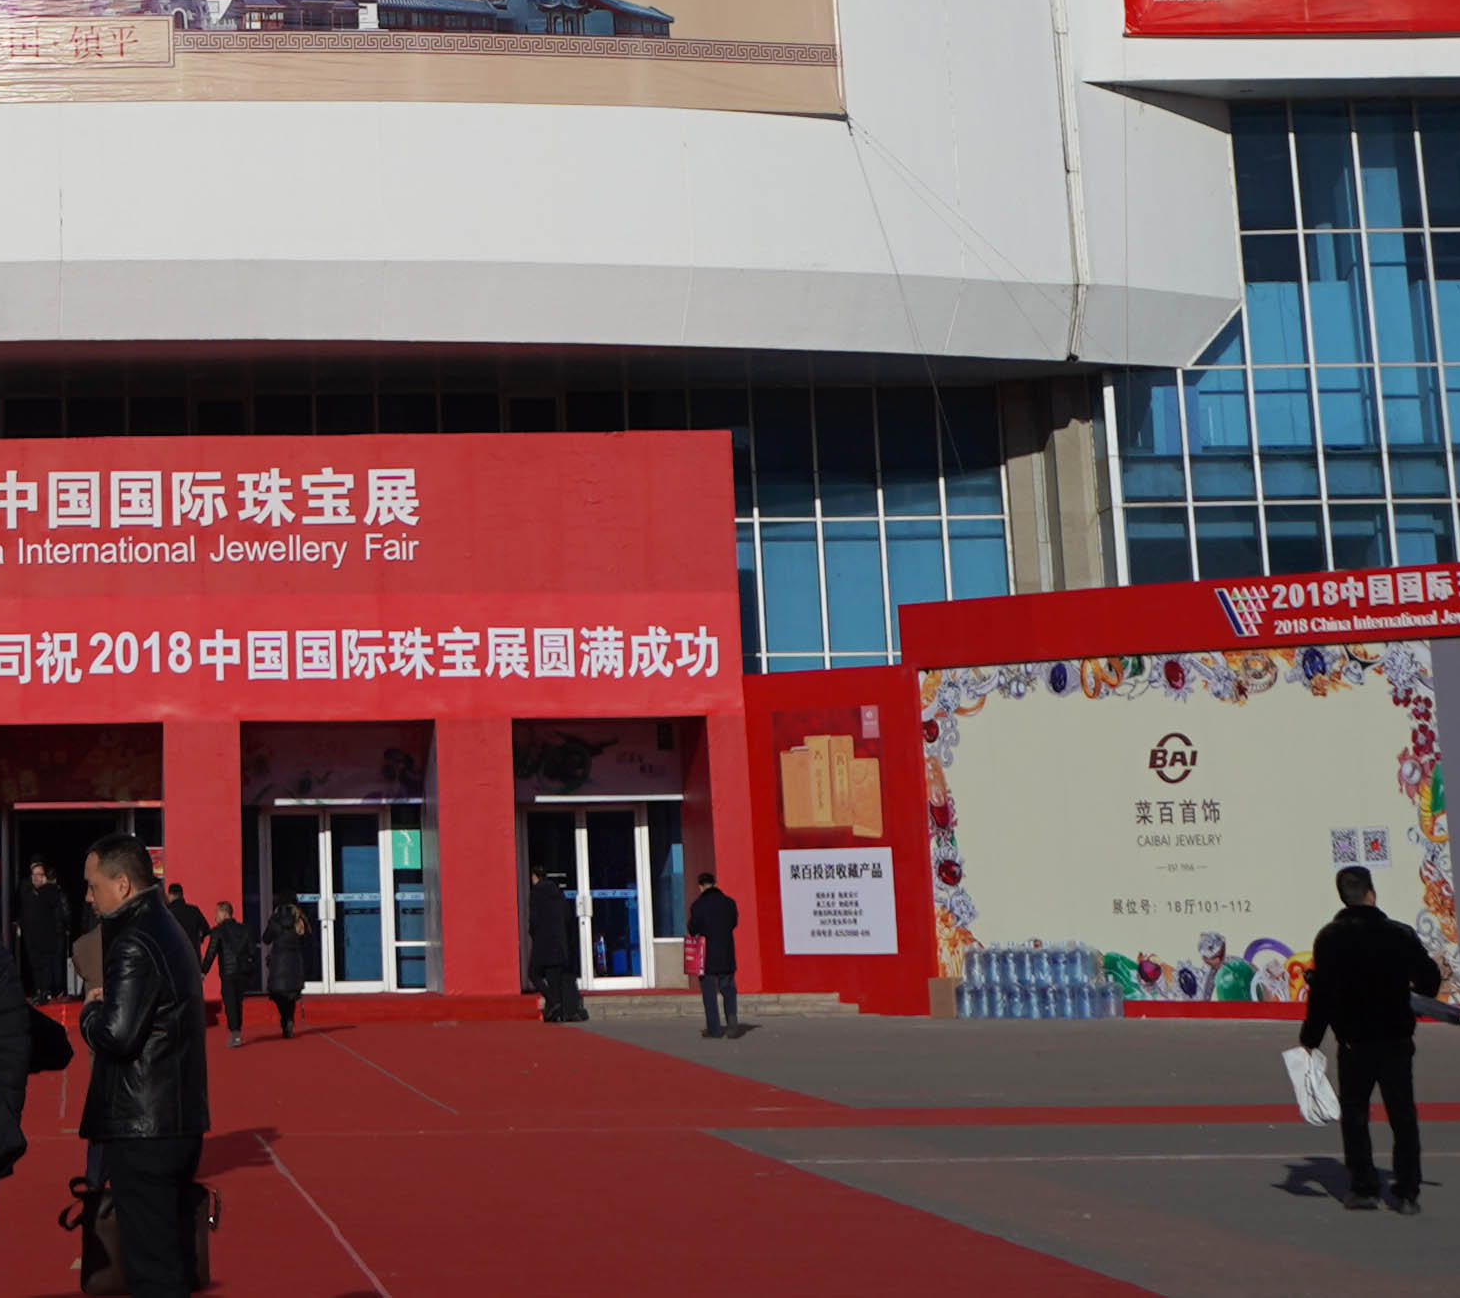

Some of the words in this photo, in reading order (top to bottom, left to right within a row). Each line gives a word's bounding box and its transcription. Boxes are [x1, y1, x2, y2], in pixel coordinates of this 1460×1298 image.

[18, 535, 196, 566] International
[210, 533, 348, 570] Jewellery
[365, 533, 419, 562] Fair
[1274, 619, 1307, 635] 2018
[1310, 617, 1351, 633] China
[1353, 610, 1437, 631] International
[1135, 798, 1221, 825] 菜百首饰
[1136, 835, 1171, 847] CAIBAI
[1175, 833, 1222, 847] JEWELRY
[790, 862, 883, 880] 菜百投资收藏产品
